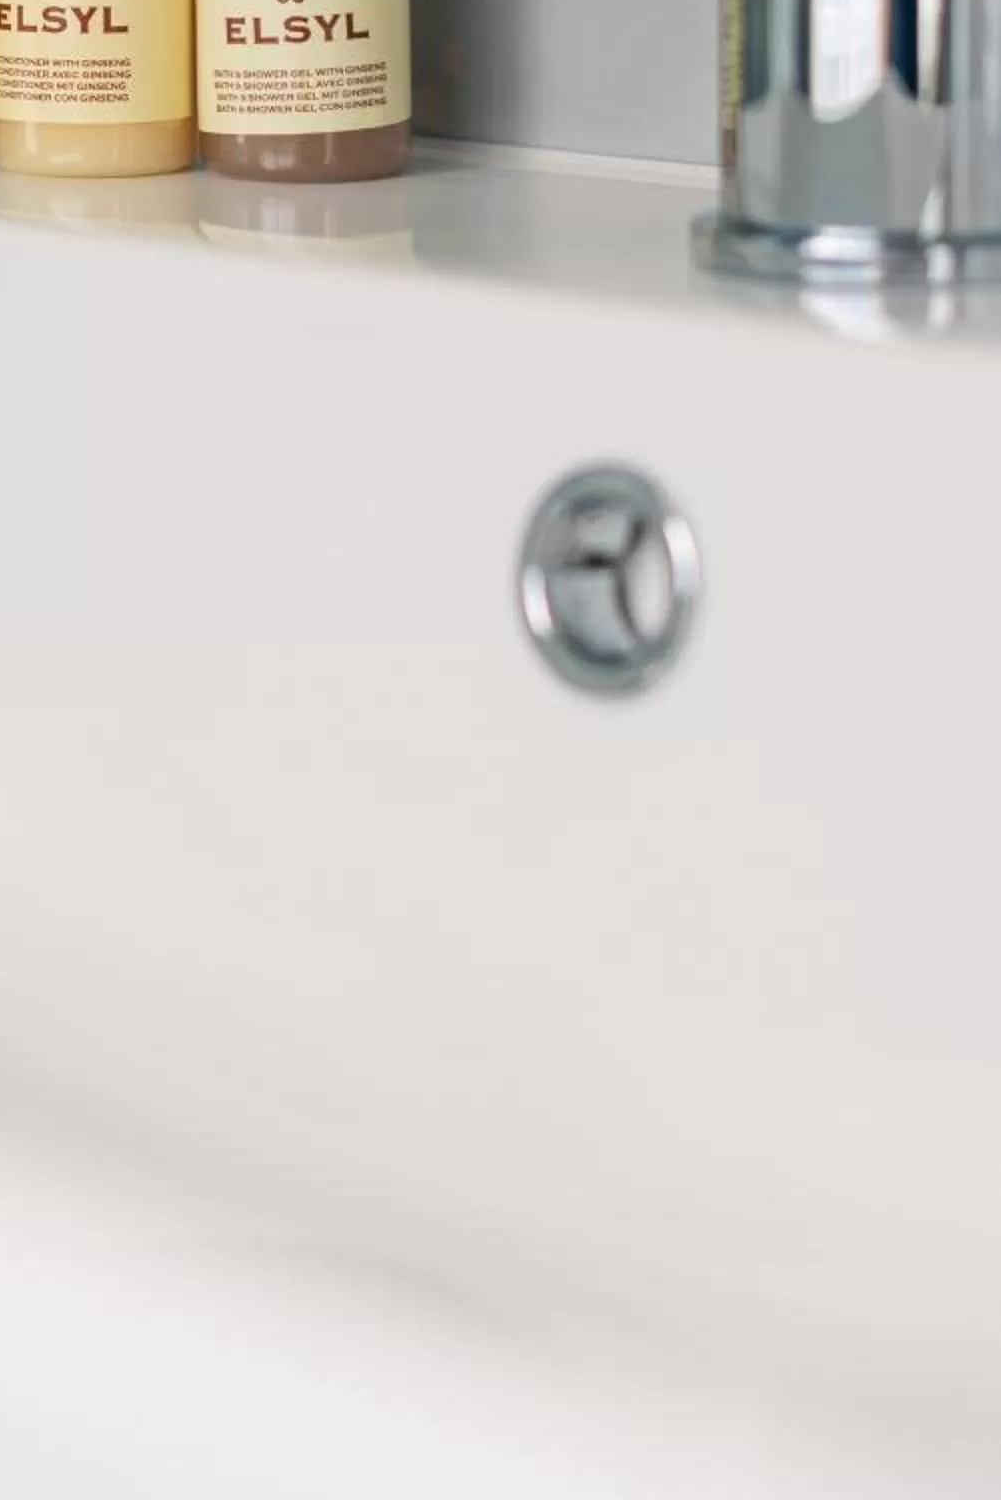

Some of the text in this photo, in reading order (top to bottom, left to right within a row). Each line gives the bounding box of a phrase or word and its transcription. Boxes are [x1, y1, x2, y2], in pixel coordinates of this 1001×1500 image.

[225, 12, 370, 45] ELSYL
[52, 59, 79, 67] WITH
[81, 58, 131, 67] GINSENG
[214, 69, 233, 78] BATH
[243, 69, 287, 78] SHOWER
[290, 69, 312, 78] GEL
[315, 67, 343, 77] WITH
[344, 62, 386, 73] GINSENG
[52, 70, 80, 78] AVEC
[81, 70, 131, 79] GINSENG
[214, 81, 233, 89] BATH
[243, 81, 288, 90] SHOWER
[290, 80, 314, 89] GEL
[315, 79, 344, 88] AVEC
[346, 74, 387, 86] GINSENG
[56, 82, 75, 90] MIT
[77, 82, 126, 90] GINSENG
[217, 93, 238, 101] BATH
[248, 93, 294, 102] SHOWER
[297, 92, 319, 101] GEL
[321, 91, 339, 100] MIT
[342, 86, 384, 98] GINSENG
[54, 93, 77, 101] CON
[80, 93, 130, 102] GINSENG
[216, 104, 239, 113] BATH
[246, 104, 292, 113] SHOWER
[295, 103, 317, 112] GEL
[319, 102, 343, 111] CON
[344, 97, 387, 109] GINSENG
